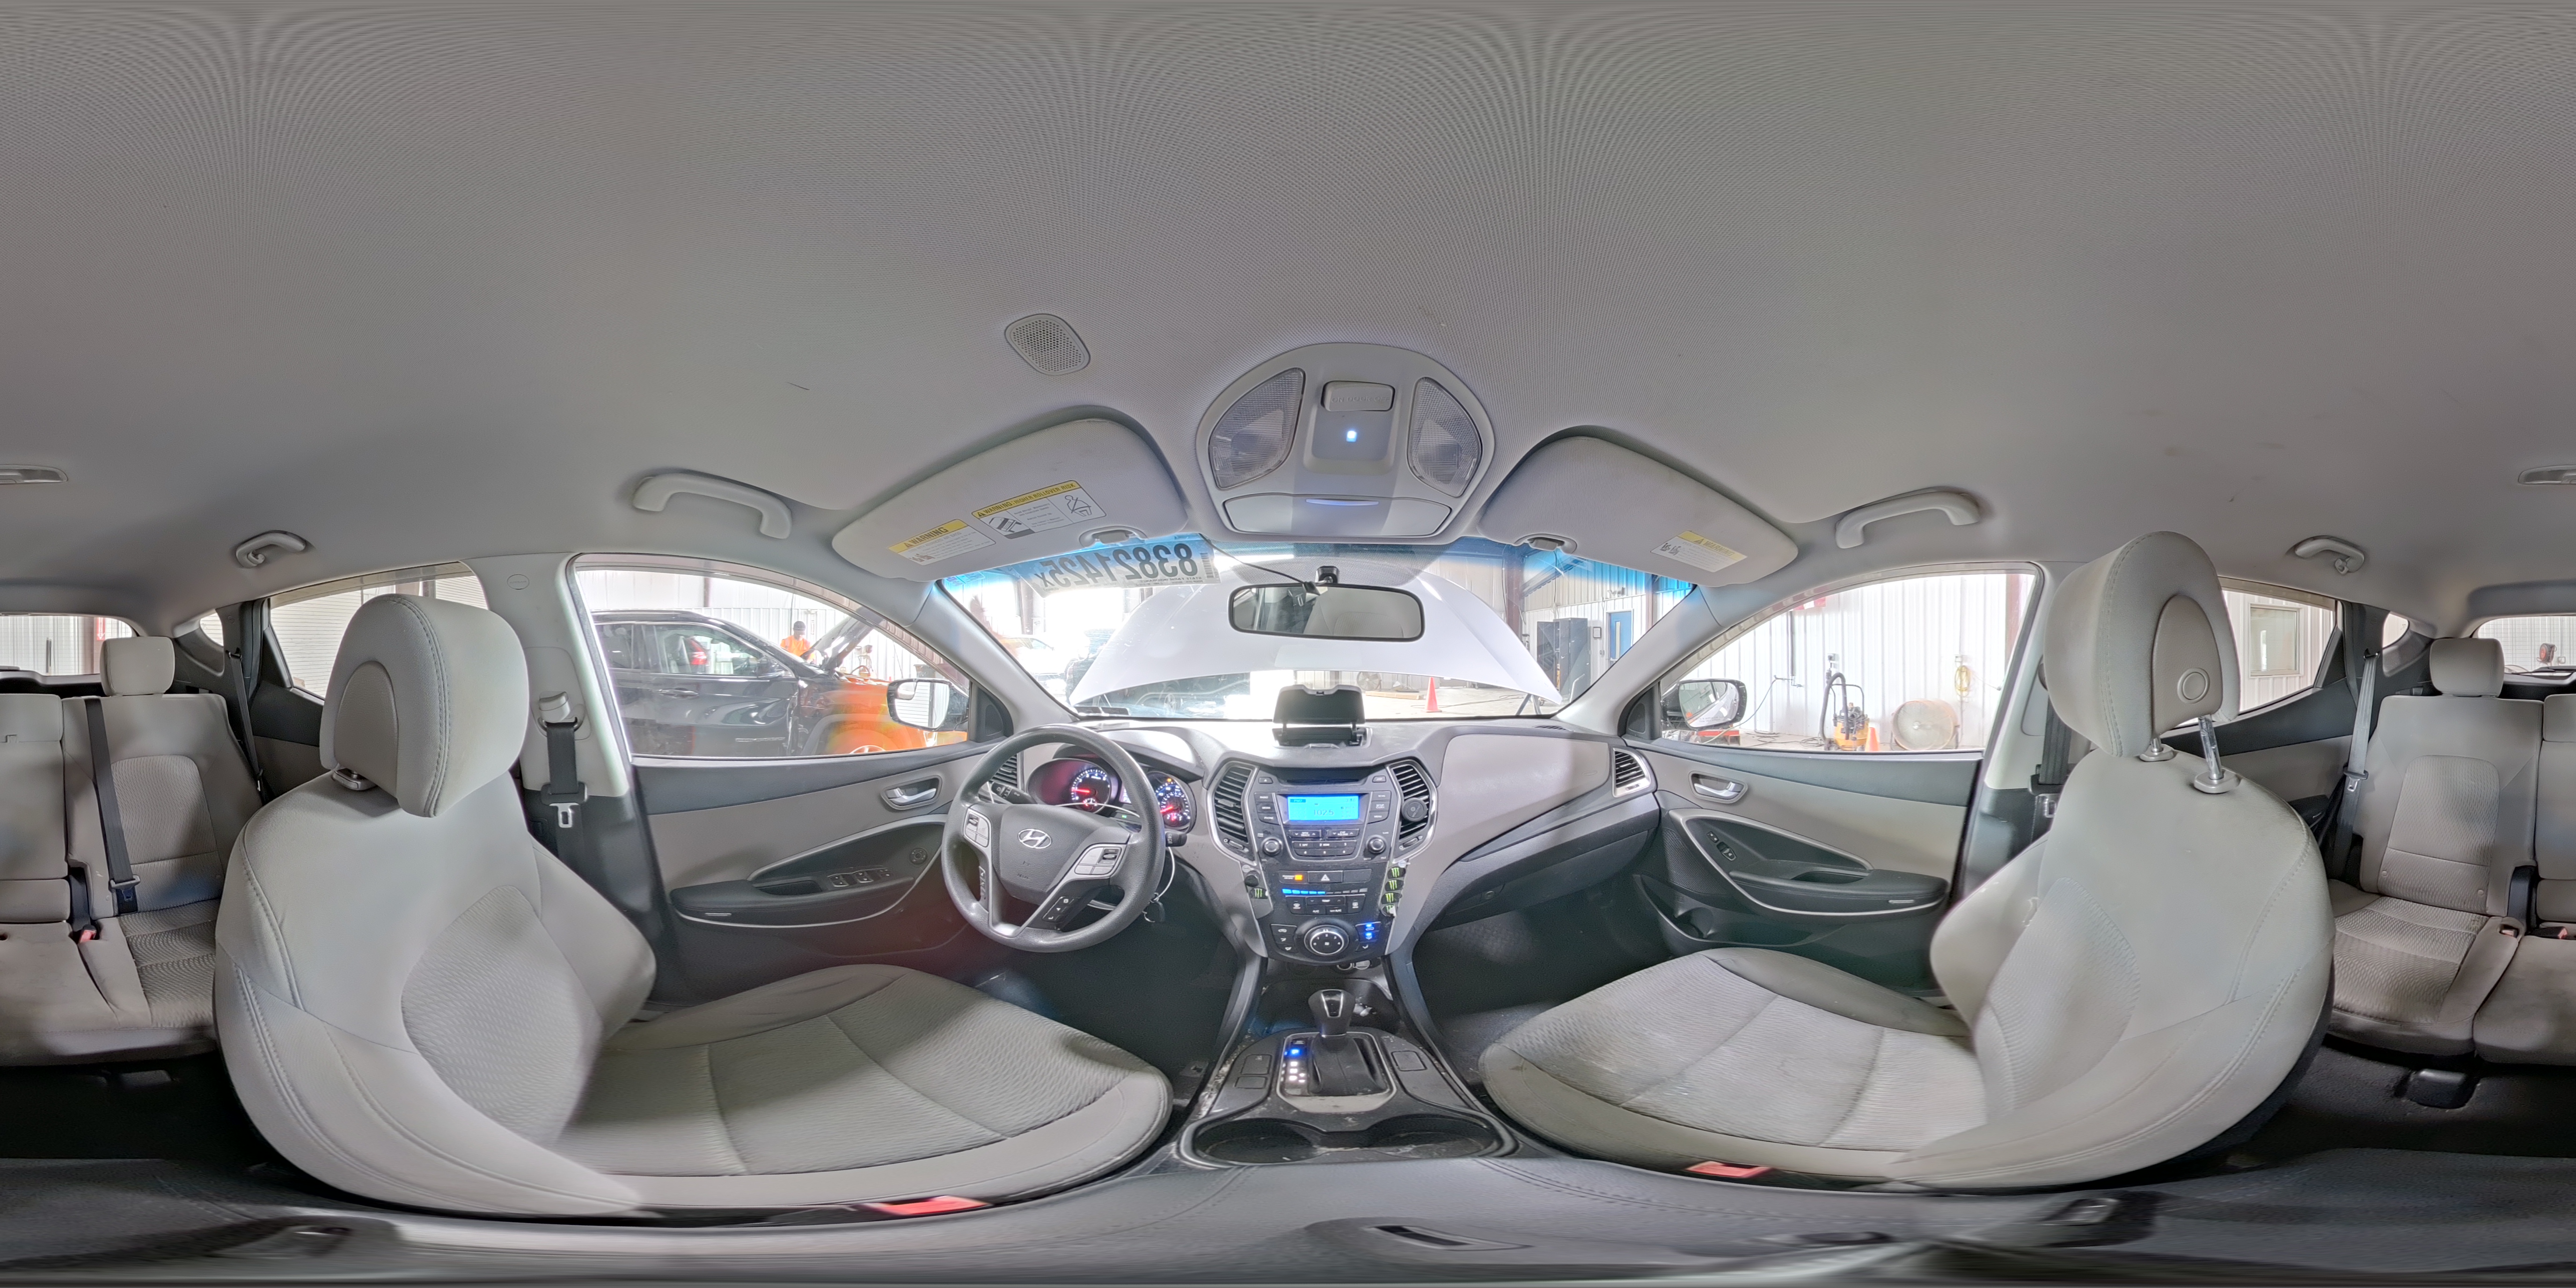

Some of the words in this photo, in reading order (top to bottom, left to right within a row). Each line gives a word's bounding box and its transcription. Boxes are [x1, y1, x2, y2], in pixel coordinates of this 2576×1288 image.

[1014, 495, 1033, 505] HIGHER
[1033, 487, 1061, 499] ROLLOVER
[909, 527, 948, 545] WARNING
[1703, 541, 1736, 556] WARNING
